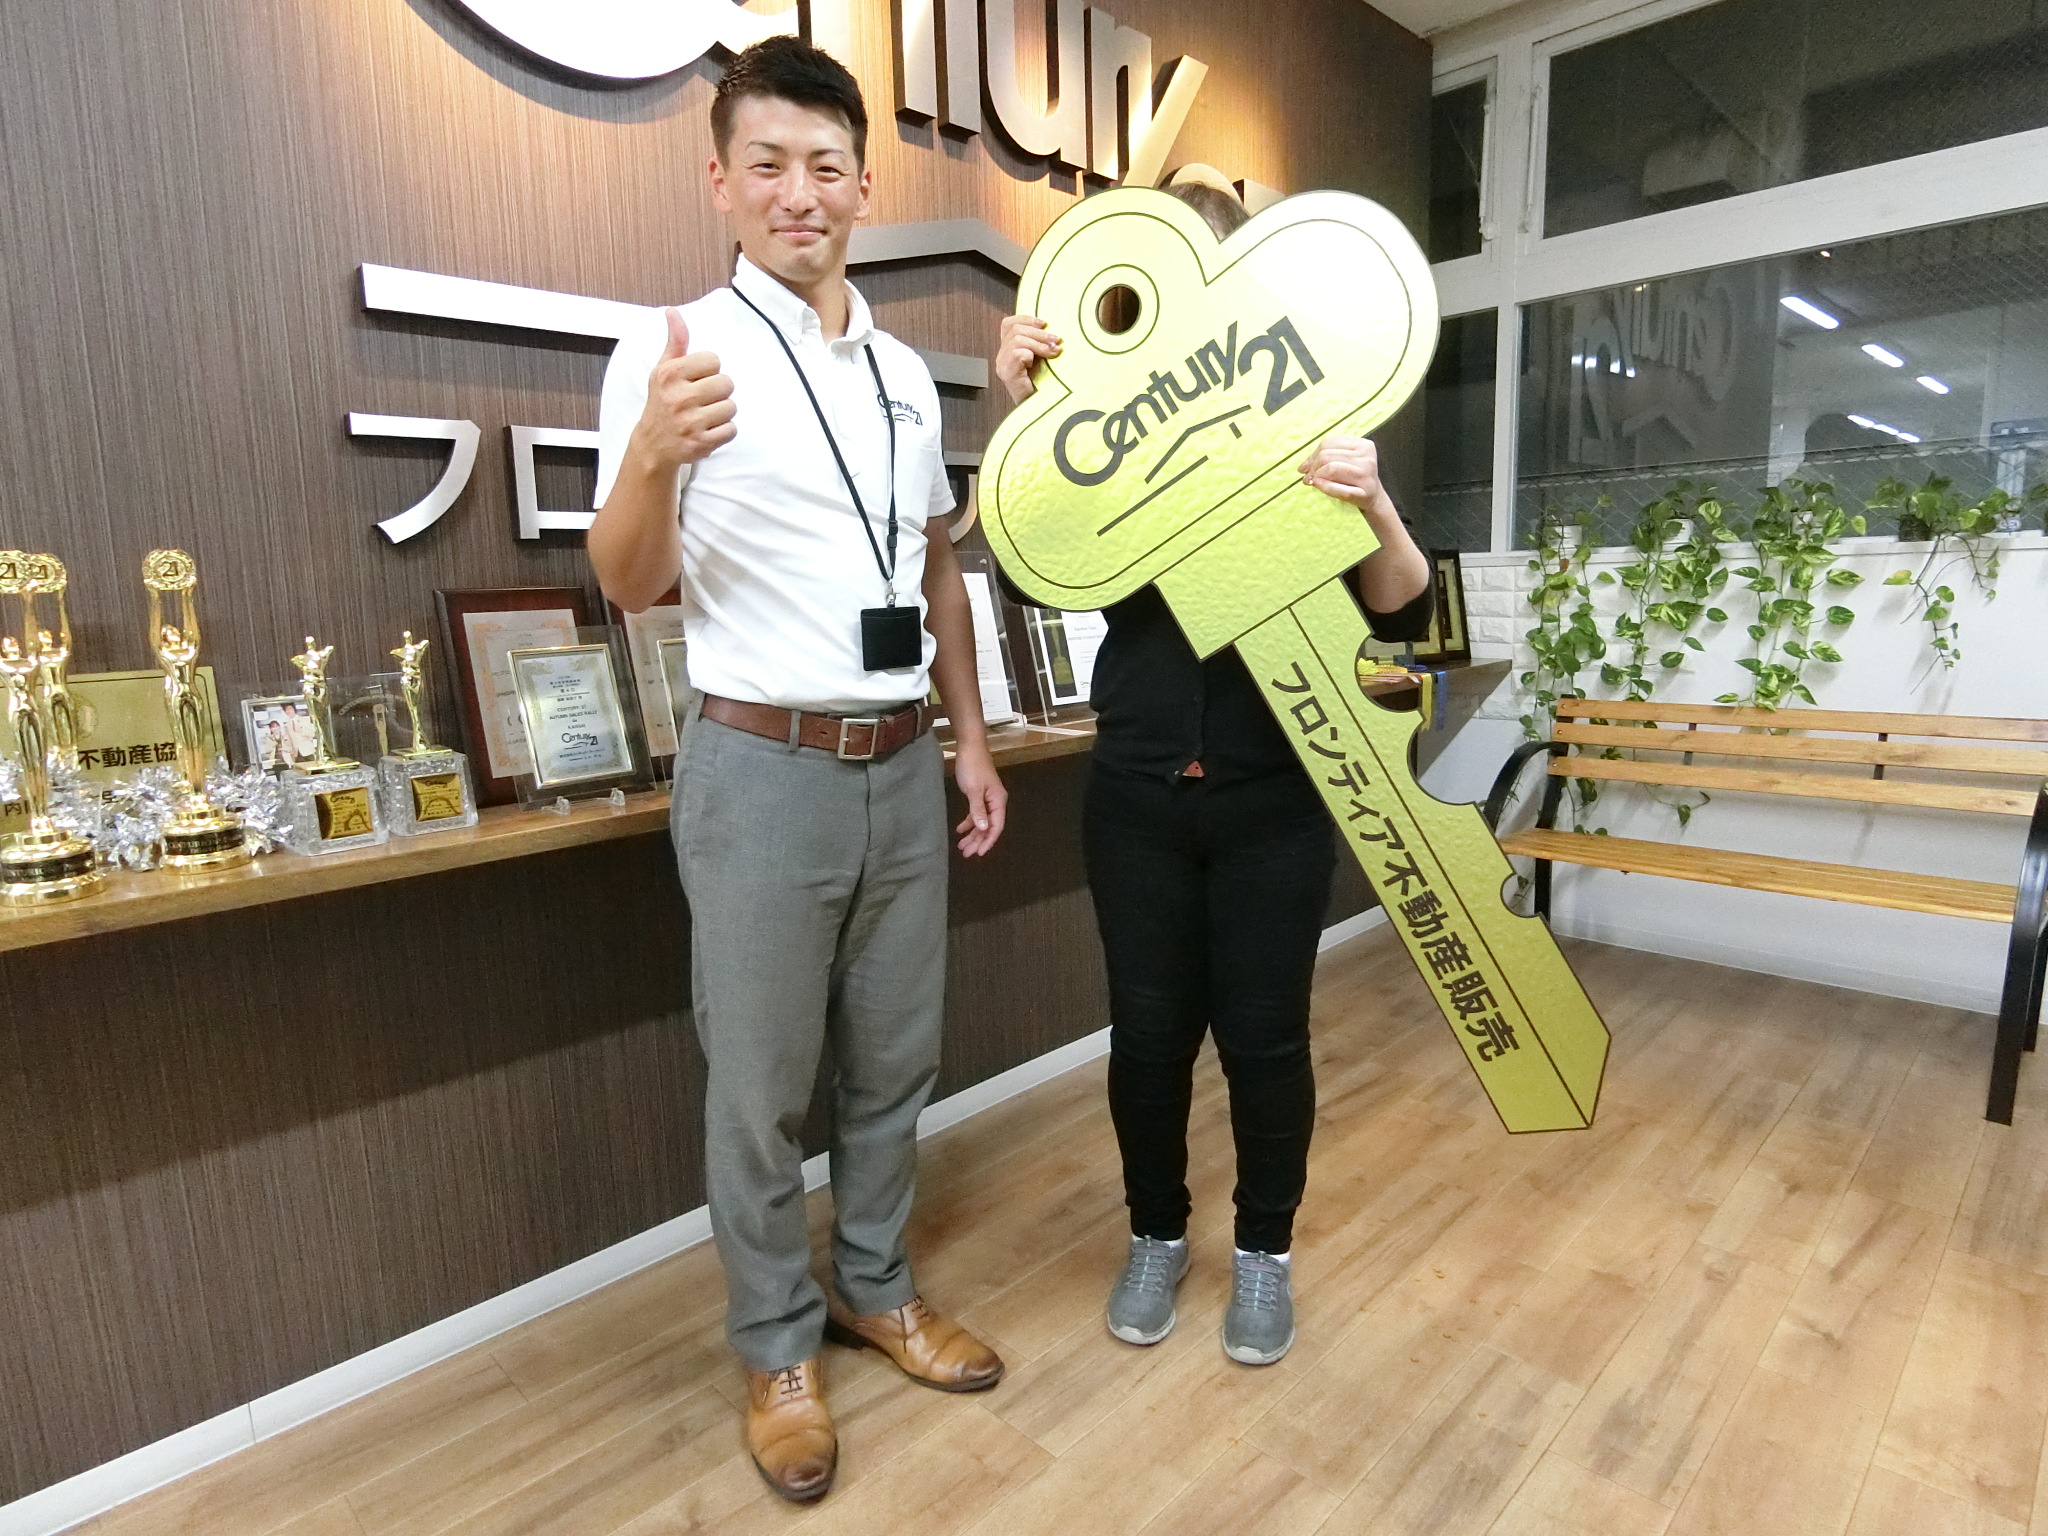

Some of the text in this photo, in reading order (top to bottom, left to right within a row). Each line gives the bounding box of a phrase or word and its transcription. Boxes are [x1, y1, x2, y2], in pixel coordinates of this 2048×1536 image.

[1054, 316, 1324, 485] Century 21
[161, 561, 179, 577] 21
[561, 732, 599, 746] Century 21
[1271, 661, 1521, 1062] フロンティア不動産販売
